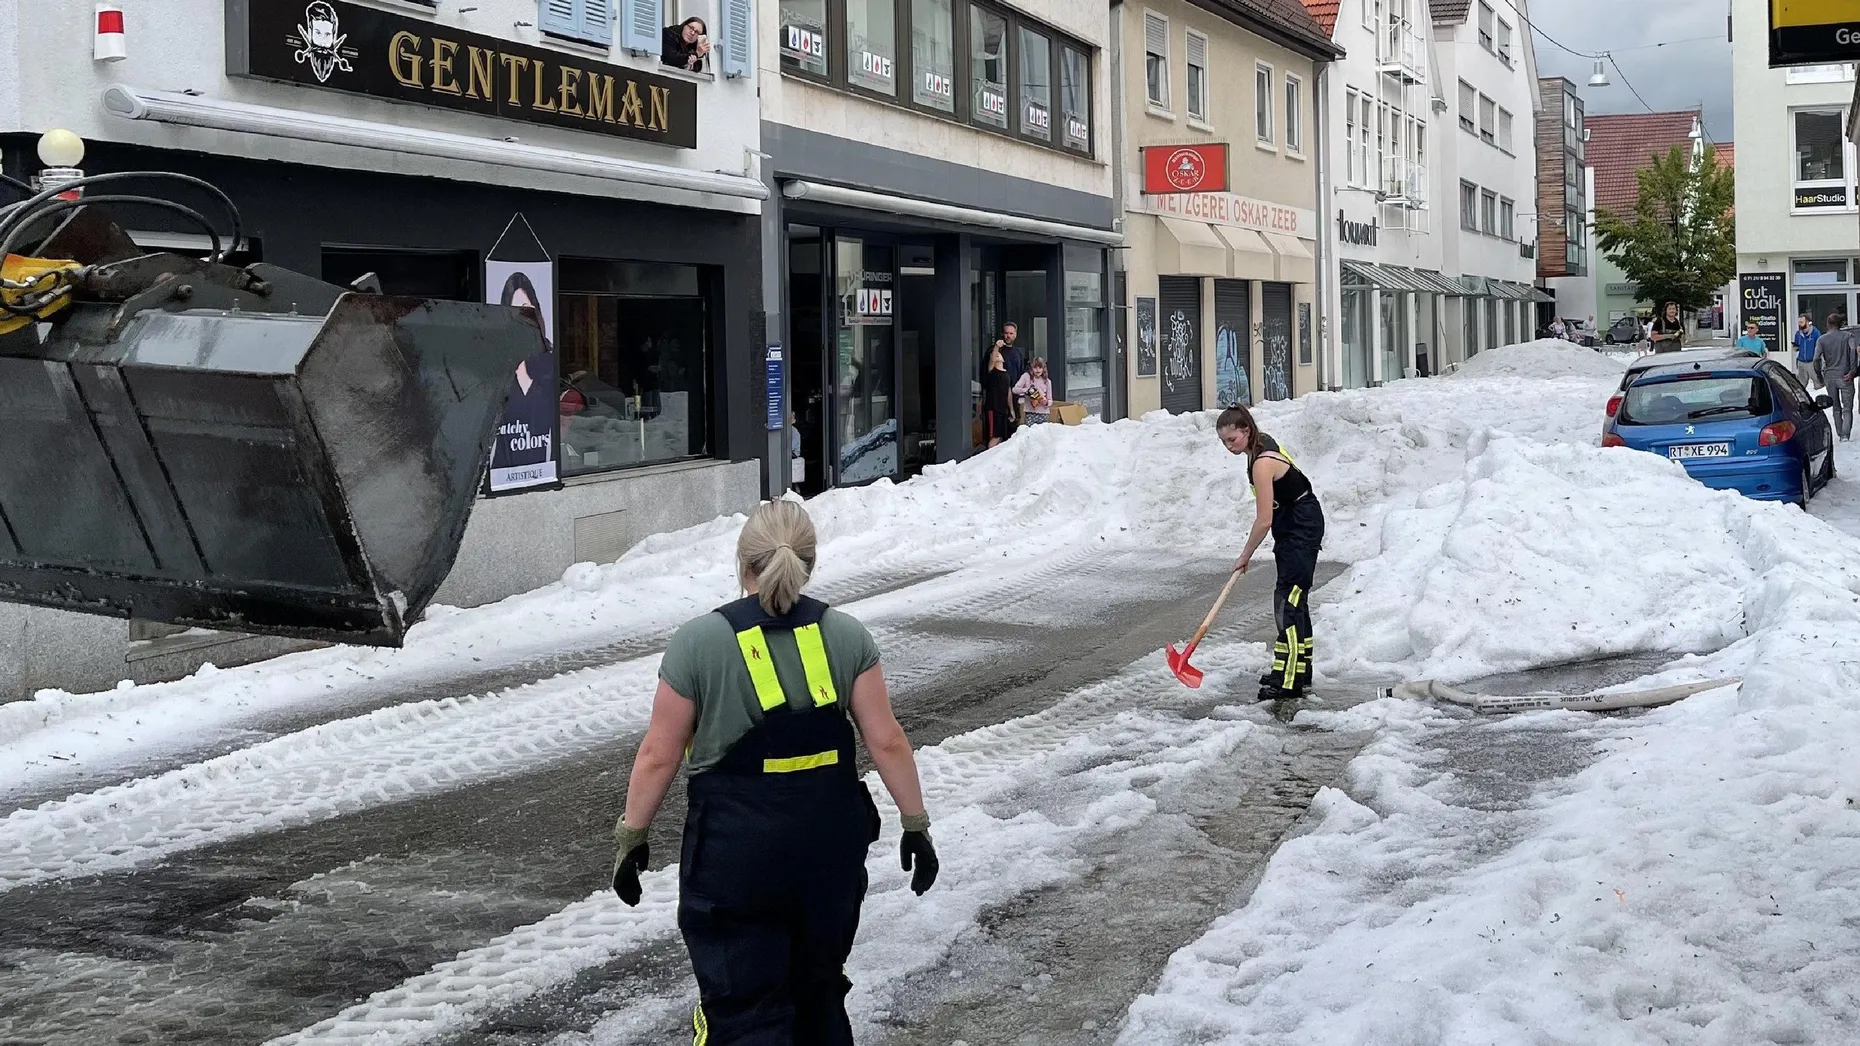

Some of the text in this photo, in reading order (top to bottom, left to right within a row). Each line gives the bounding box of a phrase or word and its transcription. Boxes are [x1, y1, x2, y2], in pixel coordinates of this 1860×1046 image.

[1836, 28, 1860, 44] Ge
[388, 30, 670, 133] GENTLEMAN
[1172, 169, 1199, 177] OSKAR
[1796, 194, 1845, 203] HaarStudio
[1234, 199, 1268, 226] OSKAR
[1272, 207, 1297, 232] ZEEB
[1744, 286, 1768, 299] cut
[1745, 295, 1782, 310] walk
[510, 431, 551, 451] colors
[1669, 443, 1728, 458] RT XE 994
[506, 468, 543, 482] ARTISTIQUE
